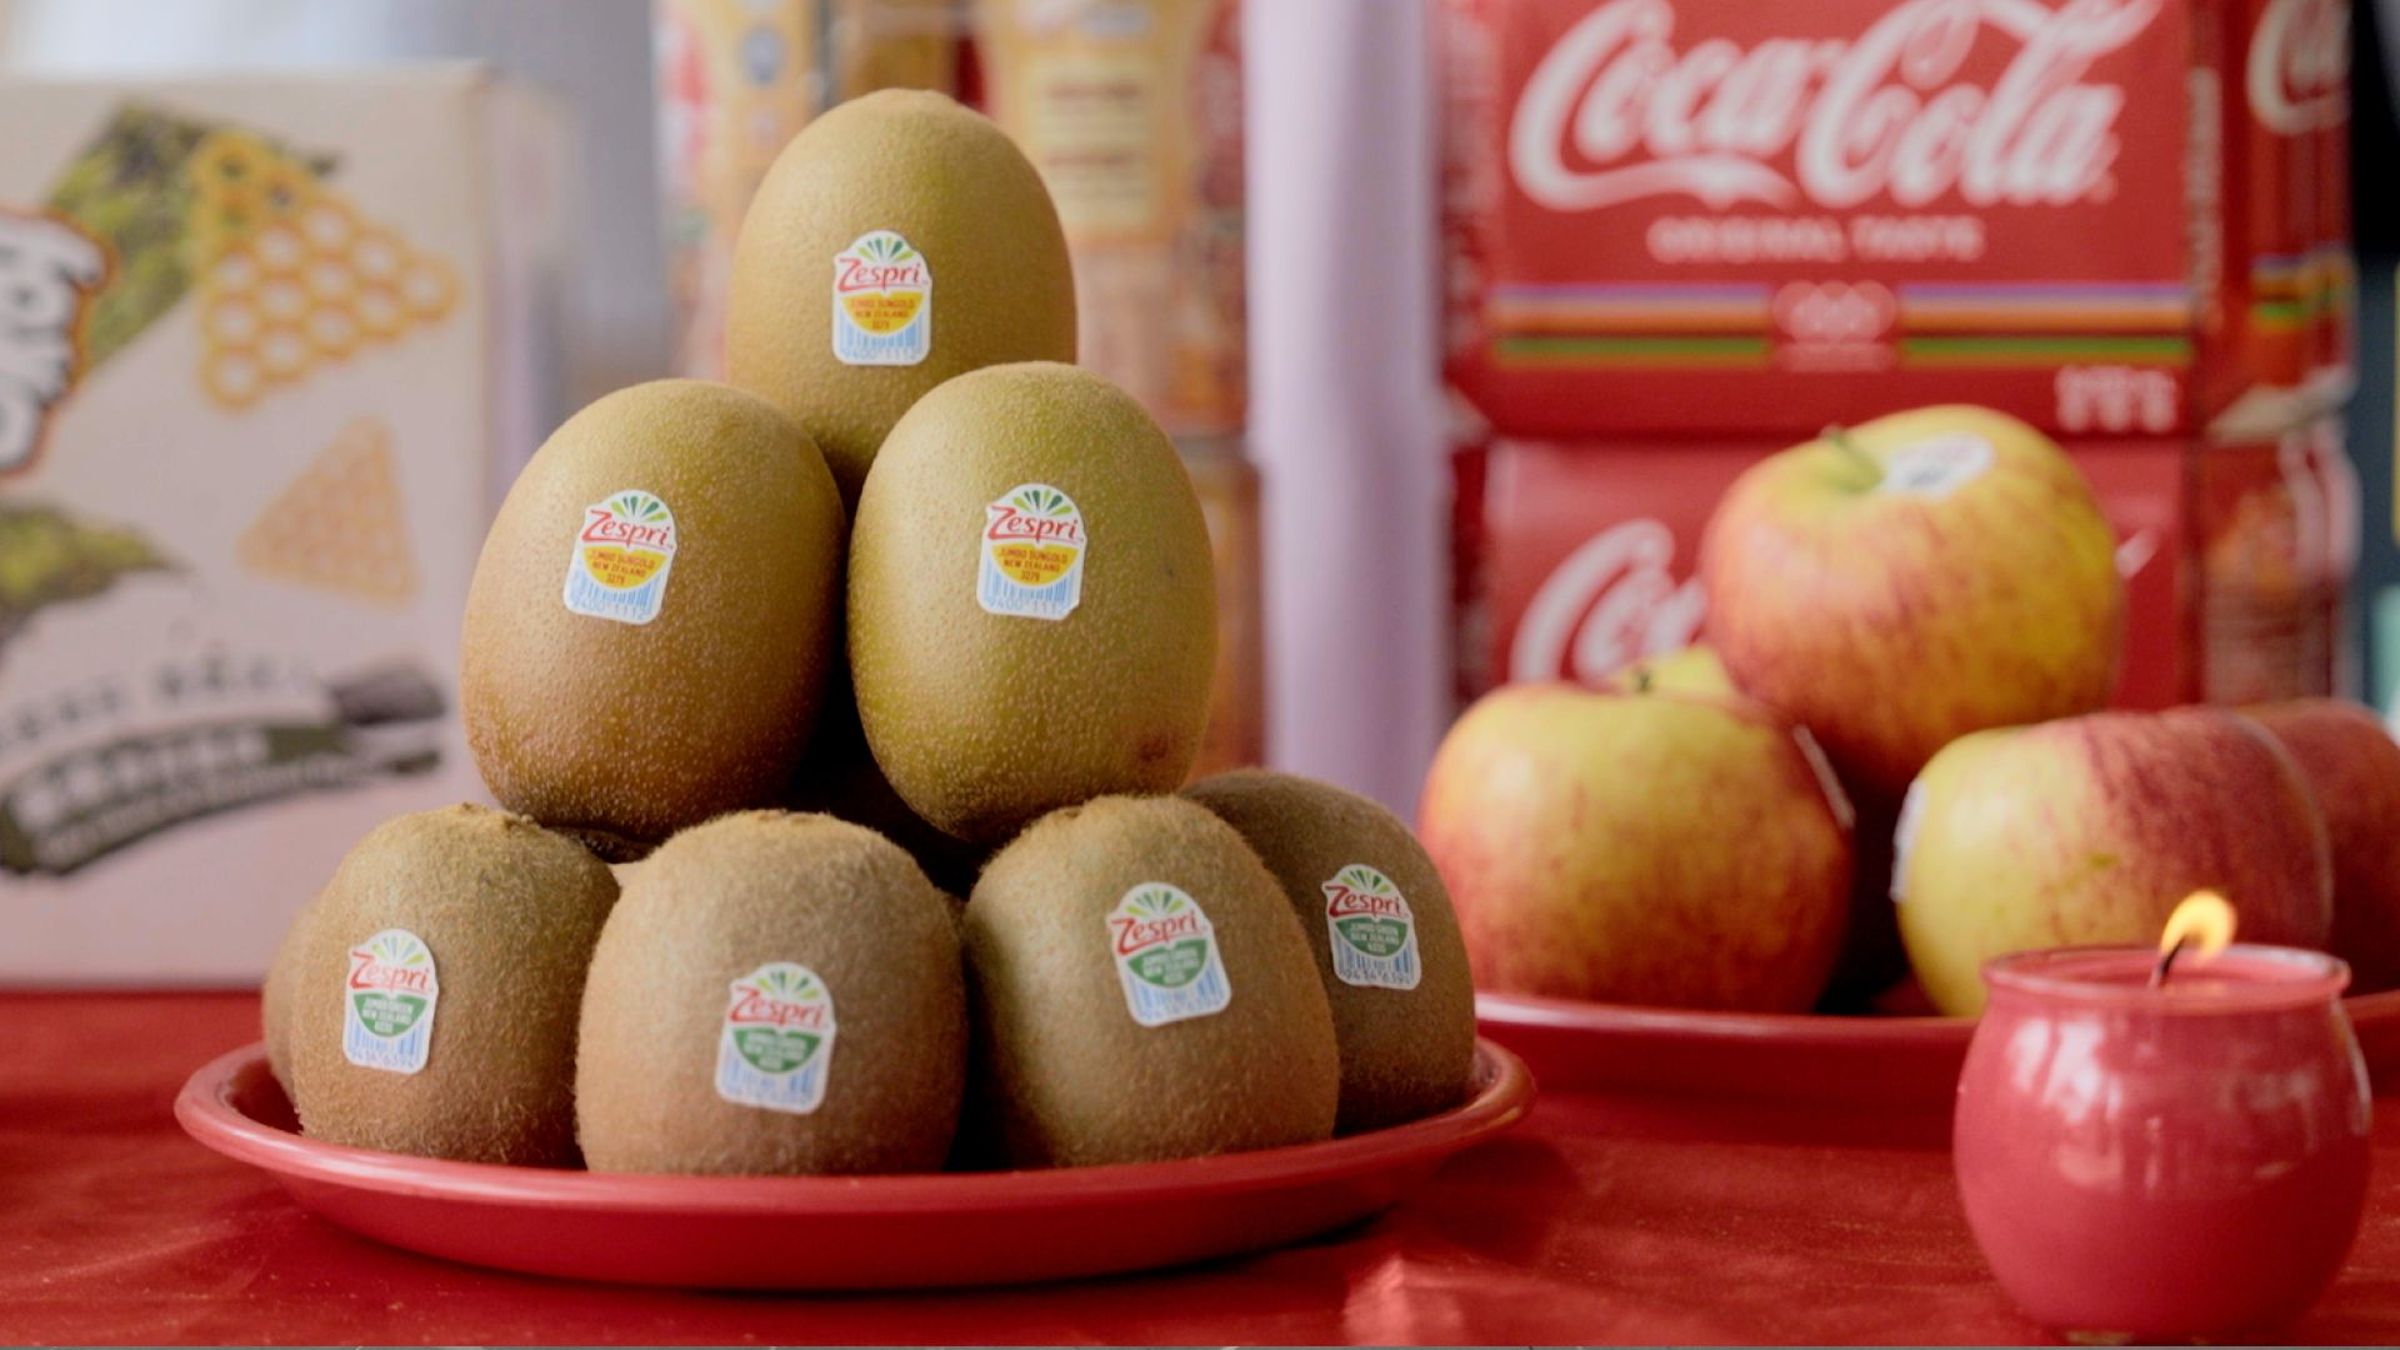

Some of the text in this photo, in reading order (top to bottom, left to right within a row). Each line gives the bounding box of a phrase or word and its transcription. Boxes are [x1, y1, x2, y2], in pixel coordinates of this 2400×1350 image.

[837, 257, 922, 293] Zespri
[581, 508, 672, 551] Zespri
[988, 503, 1080, 544] Zespri
[1324, 884, 1401, 918] Zespri
[1111, 908, 1200, 956] Zespri
[350, 950, 430, 993] Zespri
[729, 984, 827, 1030] Zespri
